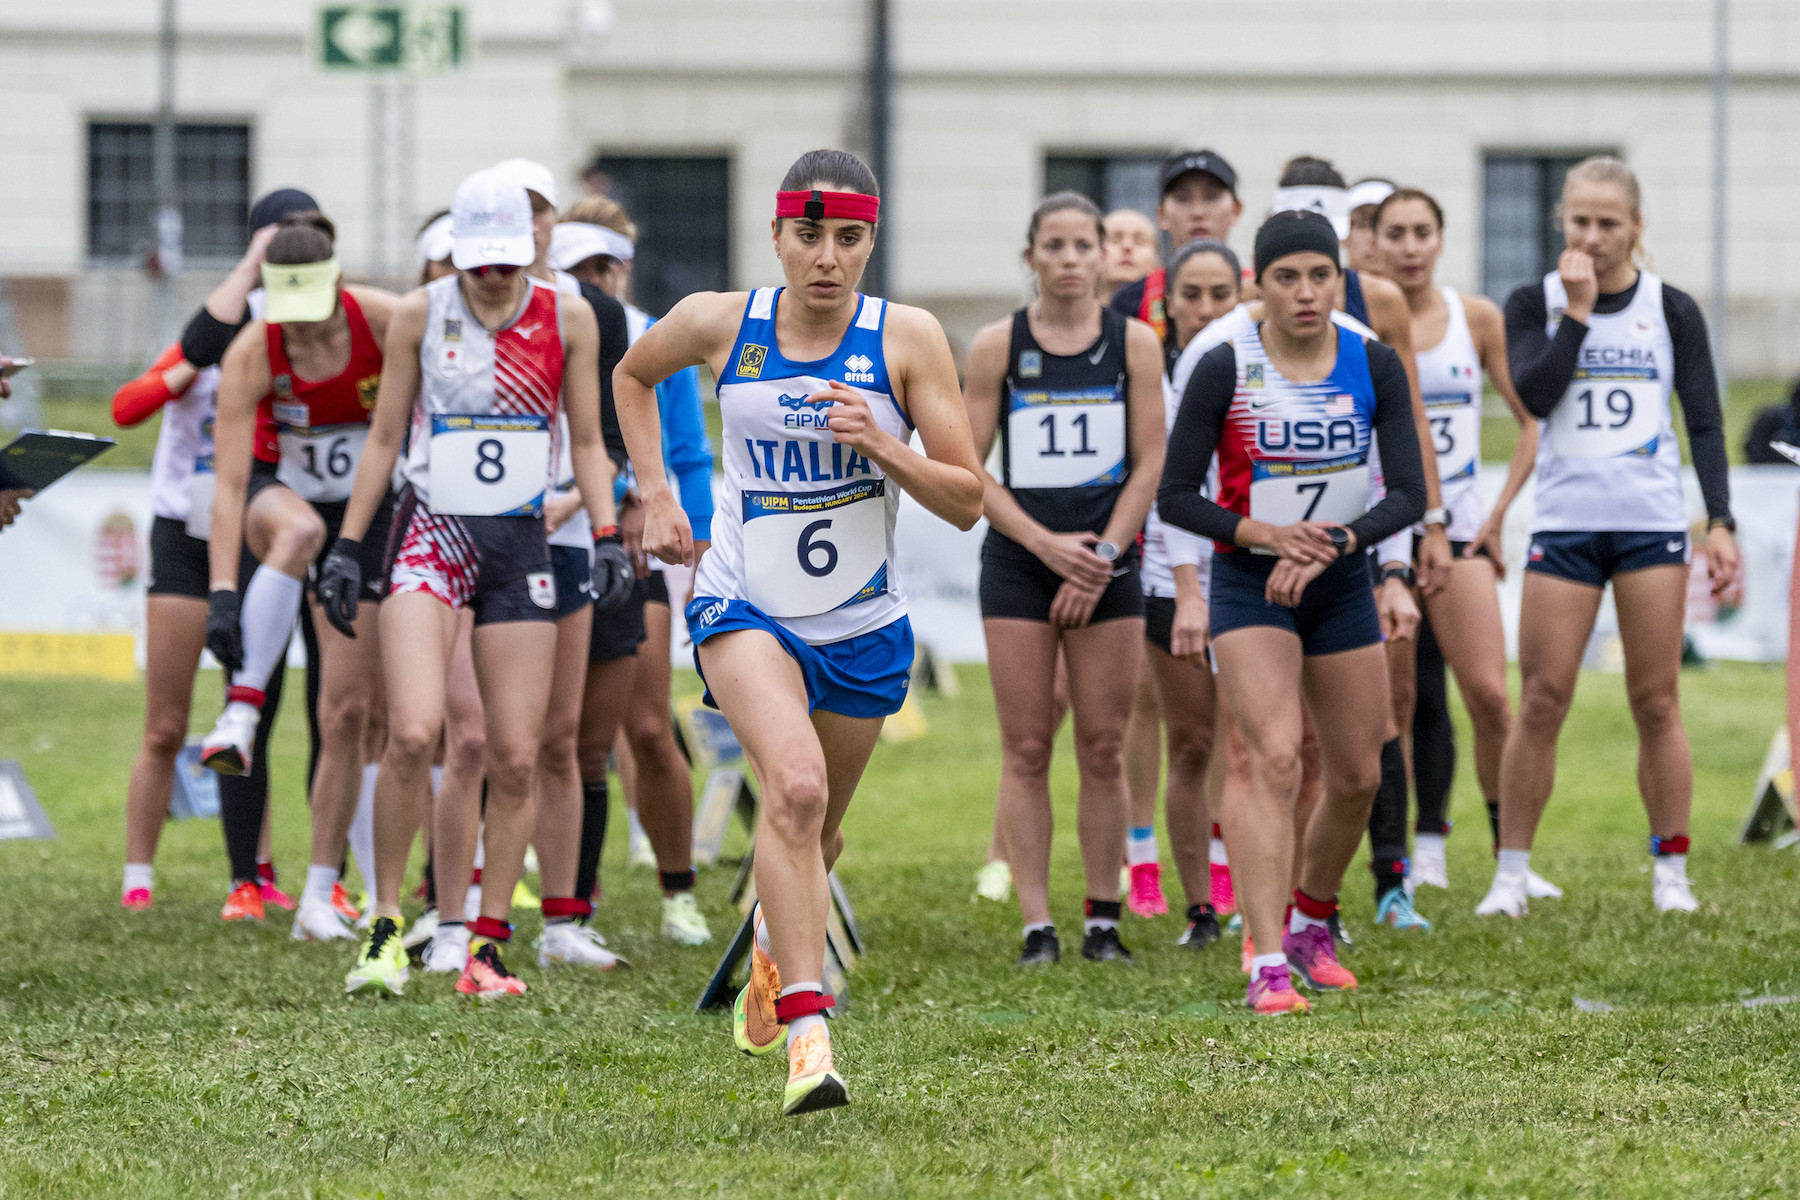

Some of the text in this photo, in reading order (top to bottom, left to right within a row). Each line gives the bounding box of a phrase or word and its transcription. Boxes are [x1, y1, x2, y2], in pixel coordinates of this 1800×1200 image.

[740, 365, 760, 375] UIPM
[1584, 348, 1656, 365] ECHIA
[784, 413, 829, 428] FIPM
[1576, 388, 1635, 430] 19
[1039, 412, 1098, 457] 11
[1259, 419, 1356, 451] USA
[302, 437, 352, 481] 16
[474, 438, 506, 484] 8
[745, 438, 871, 482] ITALIA
[761, 496, 789, 506] UIPM
[792, 485, 873, 505] Pentathlon World Cup
[825, 496, 853, 507] HUNGARY
[853, 491, 868, 500] 2024
[1295, 481, 1329, 522] 7
[797, 519, 838, 578] 6
[700, 598, 729, 630] FIPM
